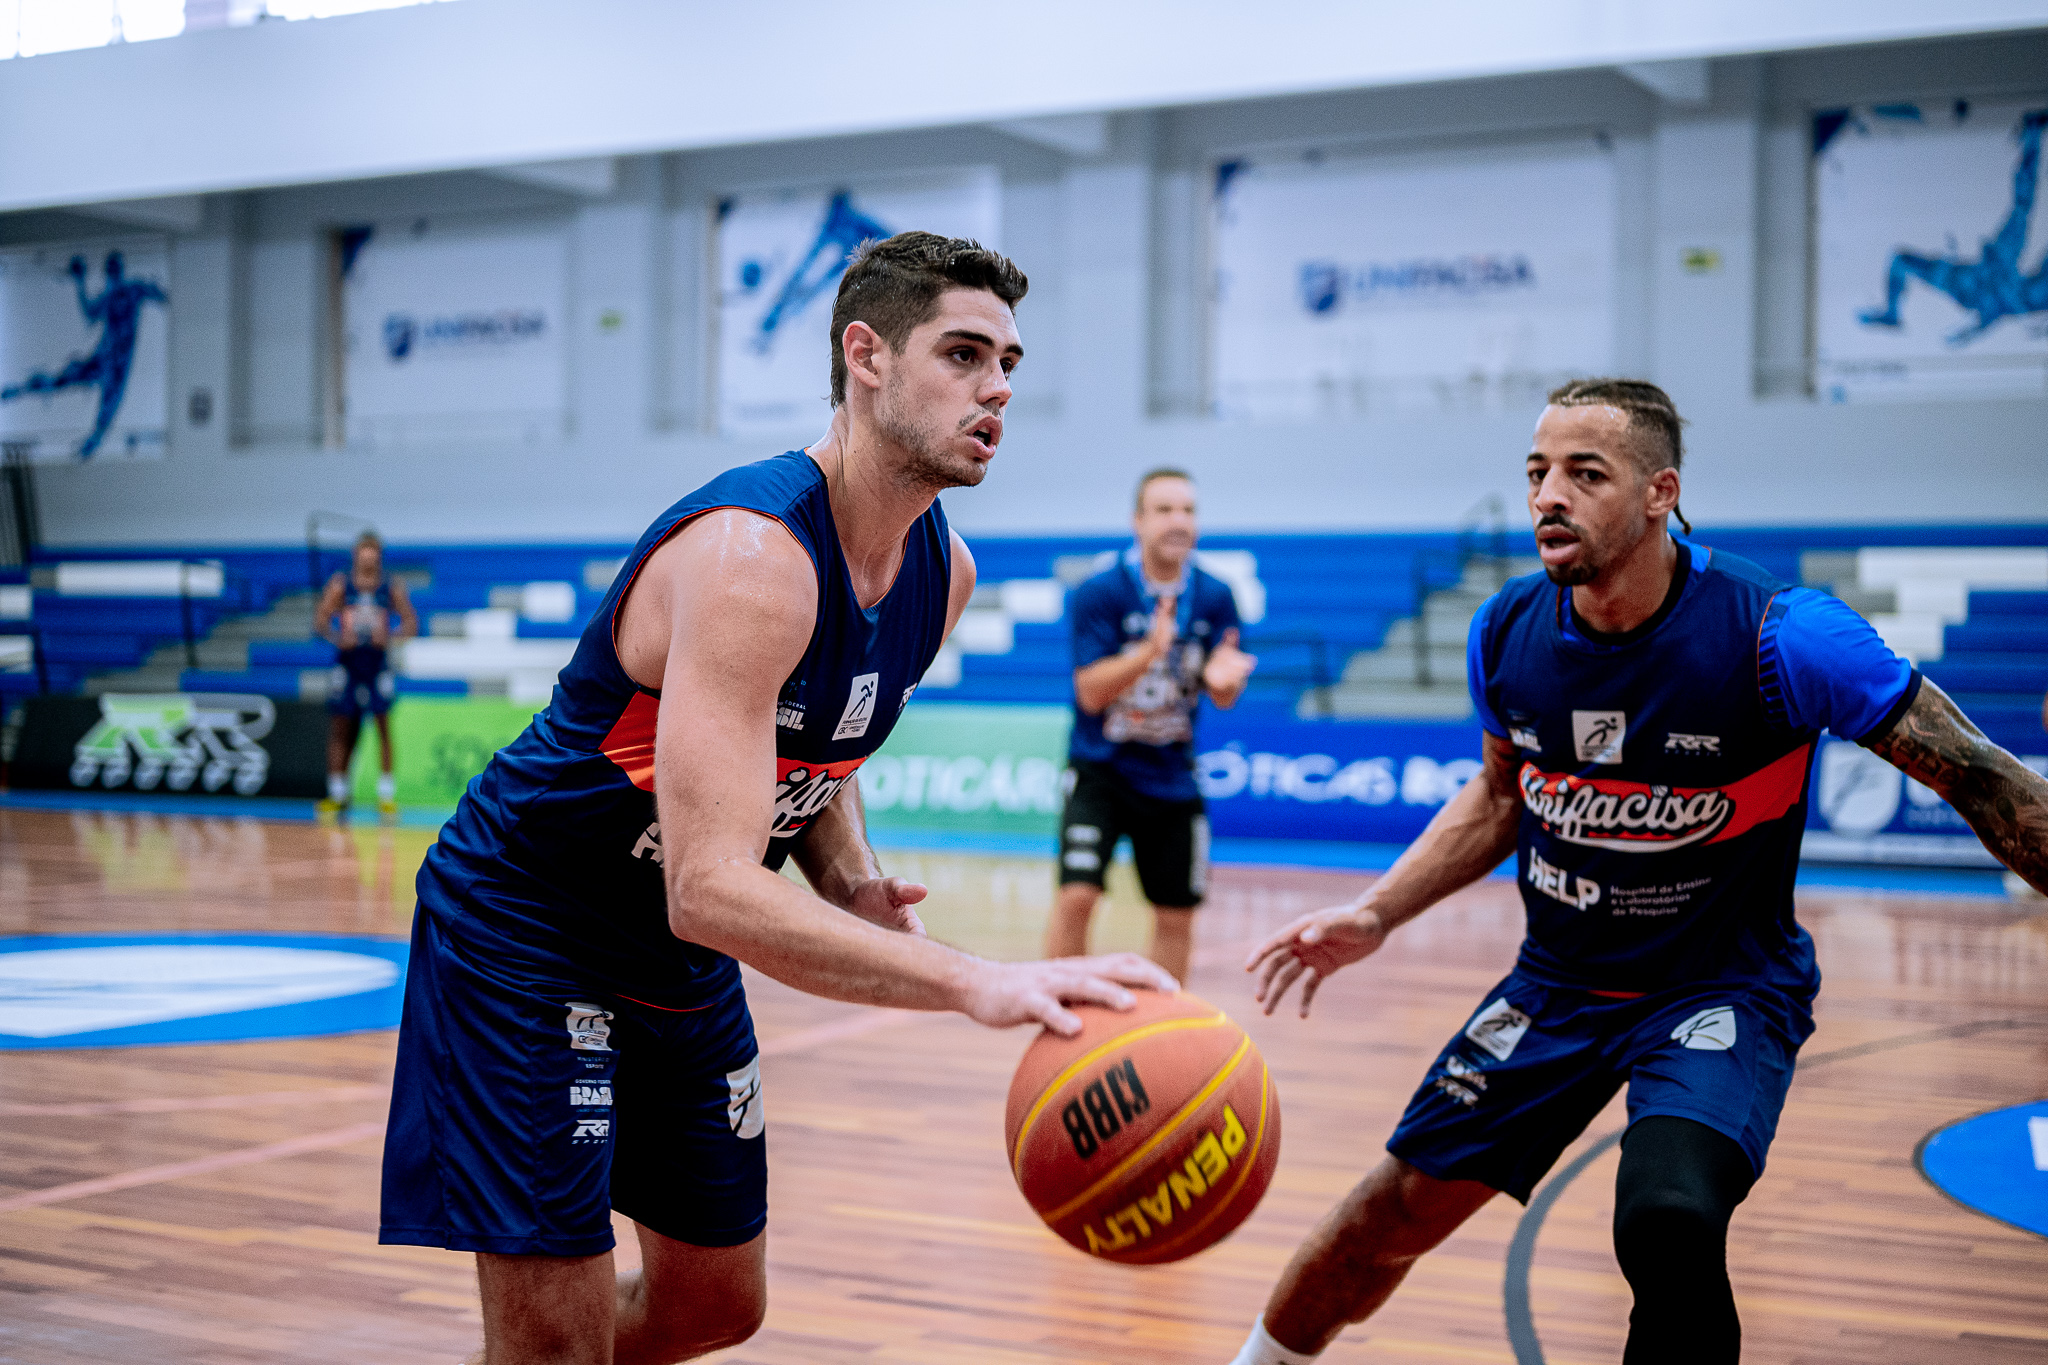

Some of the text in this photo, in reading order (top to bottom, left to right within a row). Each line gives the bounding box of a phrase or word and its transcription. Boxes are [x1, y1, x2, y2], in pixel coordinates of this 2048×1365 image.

[1521, 764, 1730, 851] Unifacisa
[1528, 846, 1601, 912] HELP
[1610, 885, 1656, 896] Hospital
[1659, 885, 1673, 894] de
[1612, 906, 1678, 916] de Pesquisa
[1083, 1104, 1246, 1256] PENALTY
